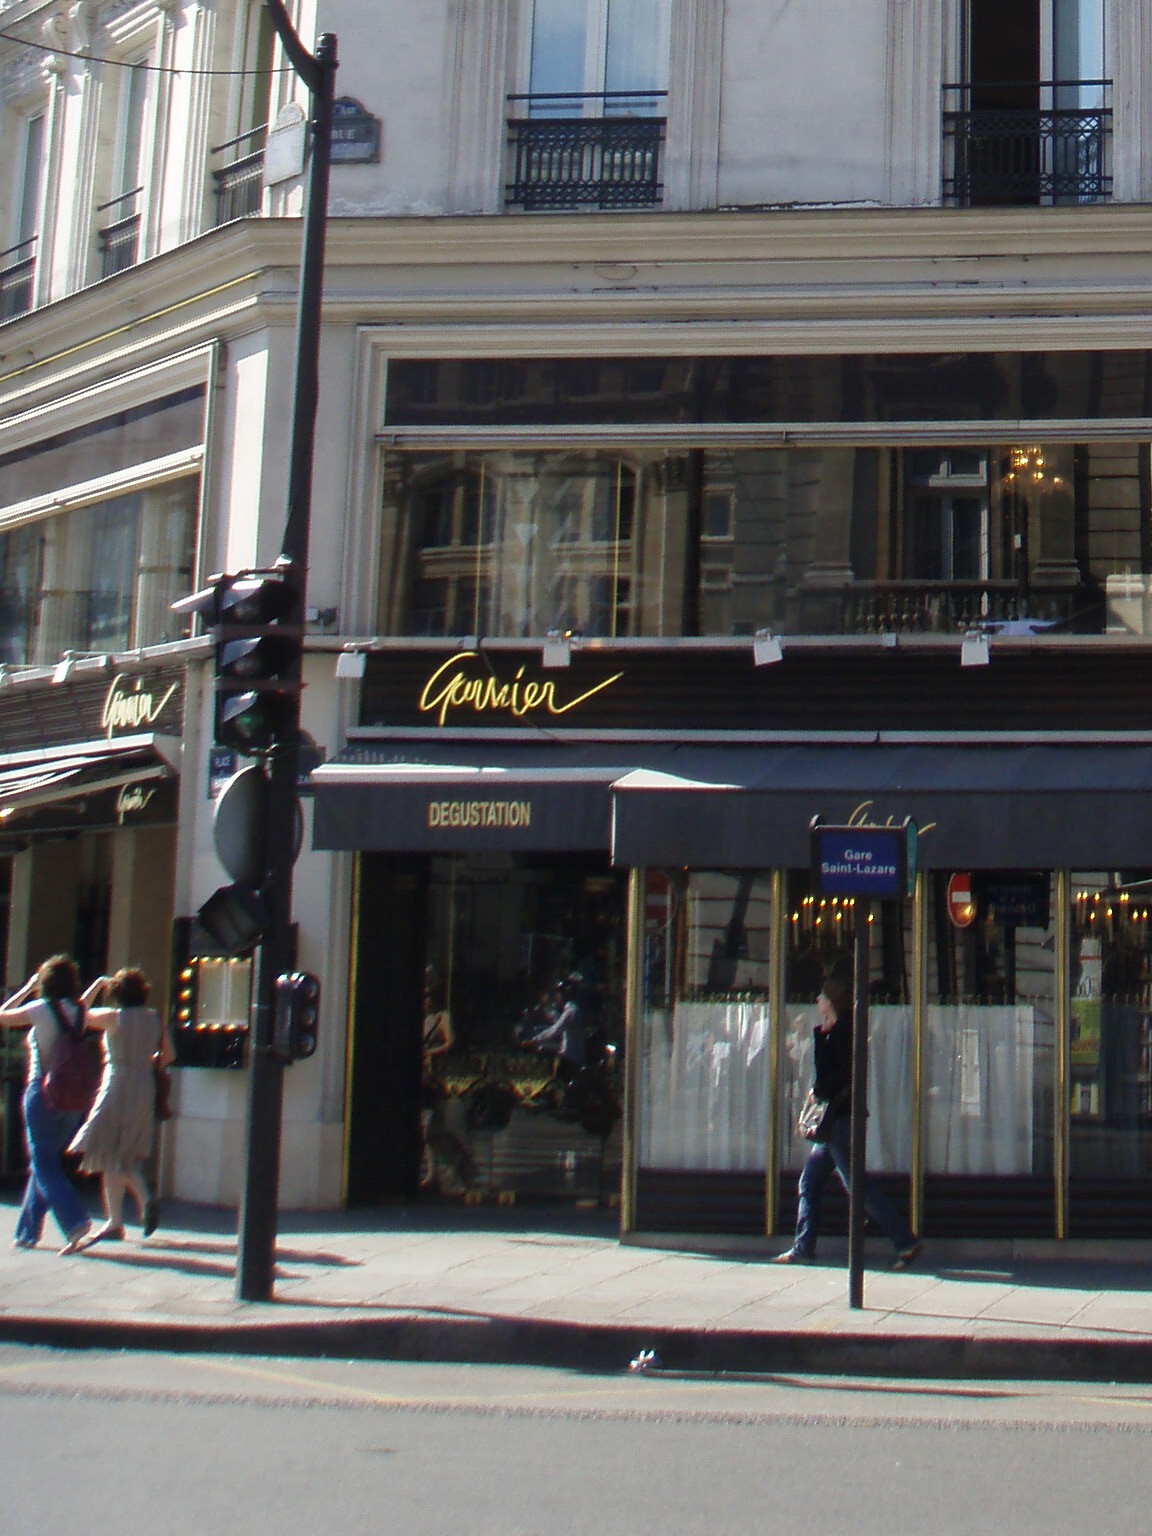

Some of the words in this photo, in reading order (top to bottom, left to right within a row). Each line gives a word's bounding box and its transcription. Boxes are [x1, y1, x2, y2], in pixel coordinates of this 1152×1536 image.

[419, 651, 625, 727] Garnier
[427, 801, 531, 828] DEGUSTATION
[843, 848, 873, 861] Gare
[821, 862, 897, 875] Saint-Lazare
